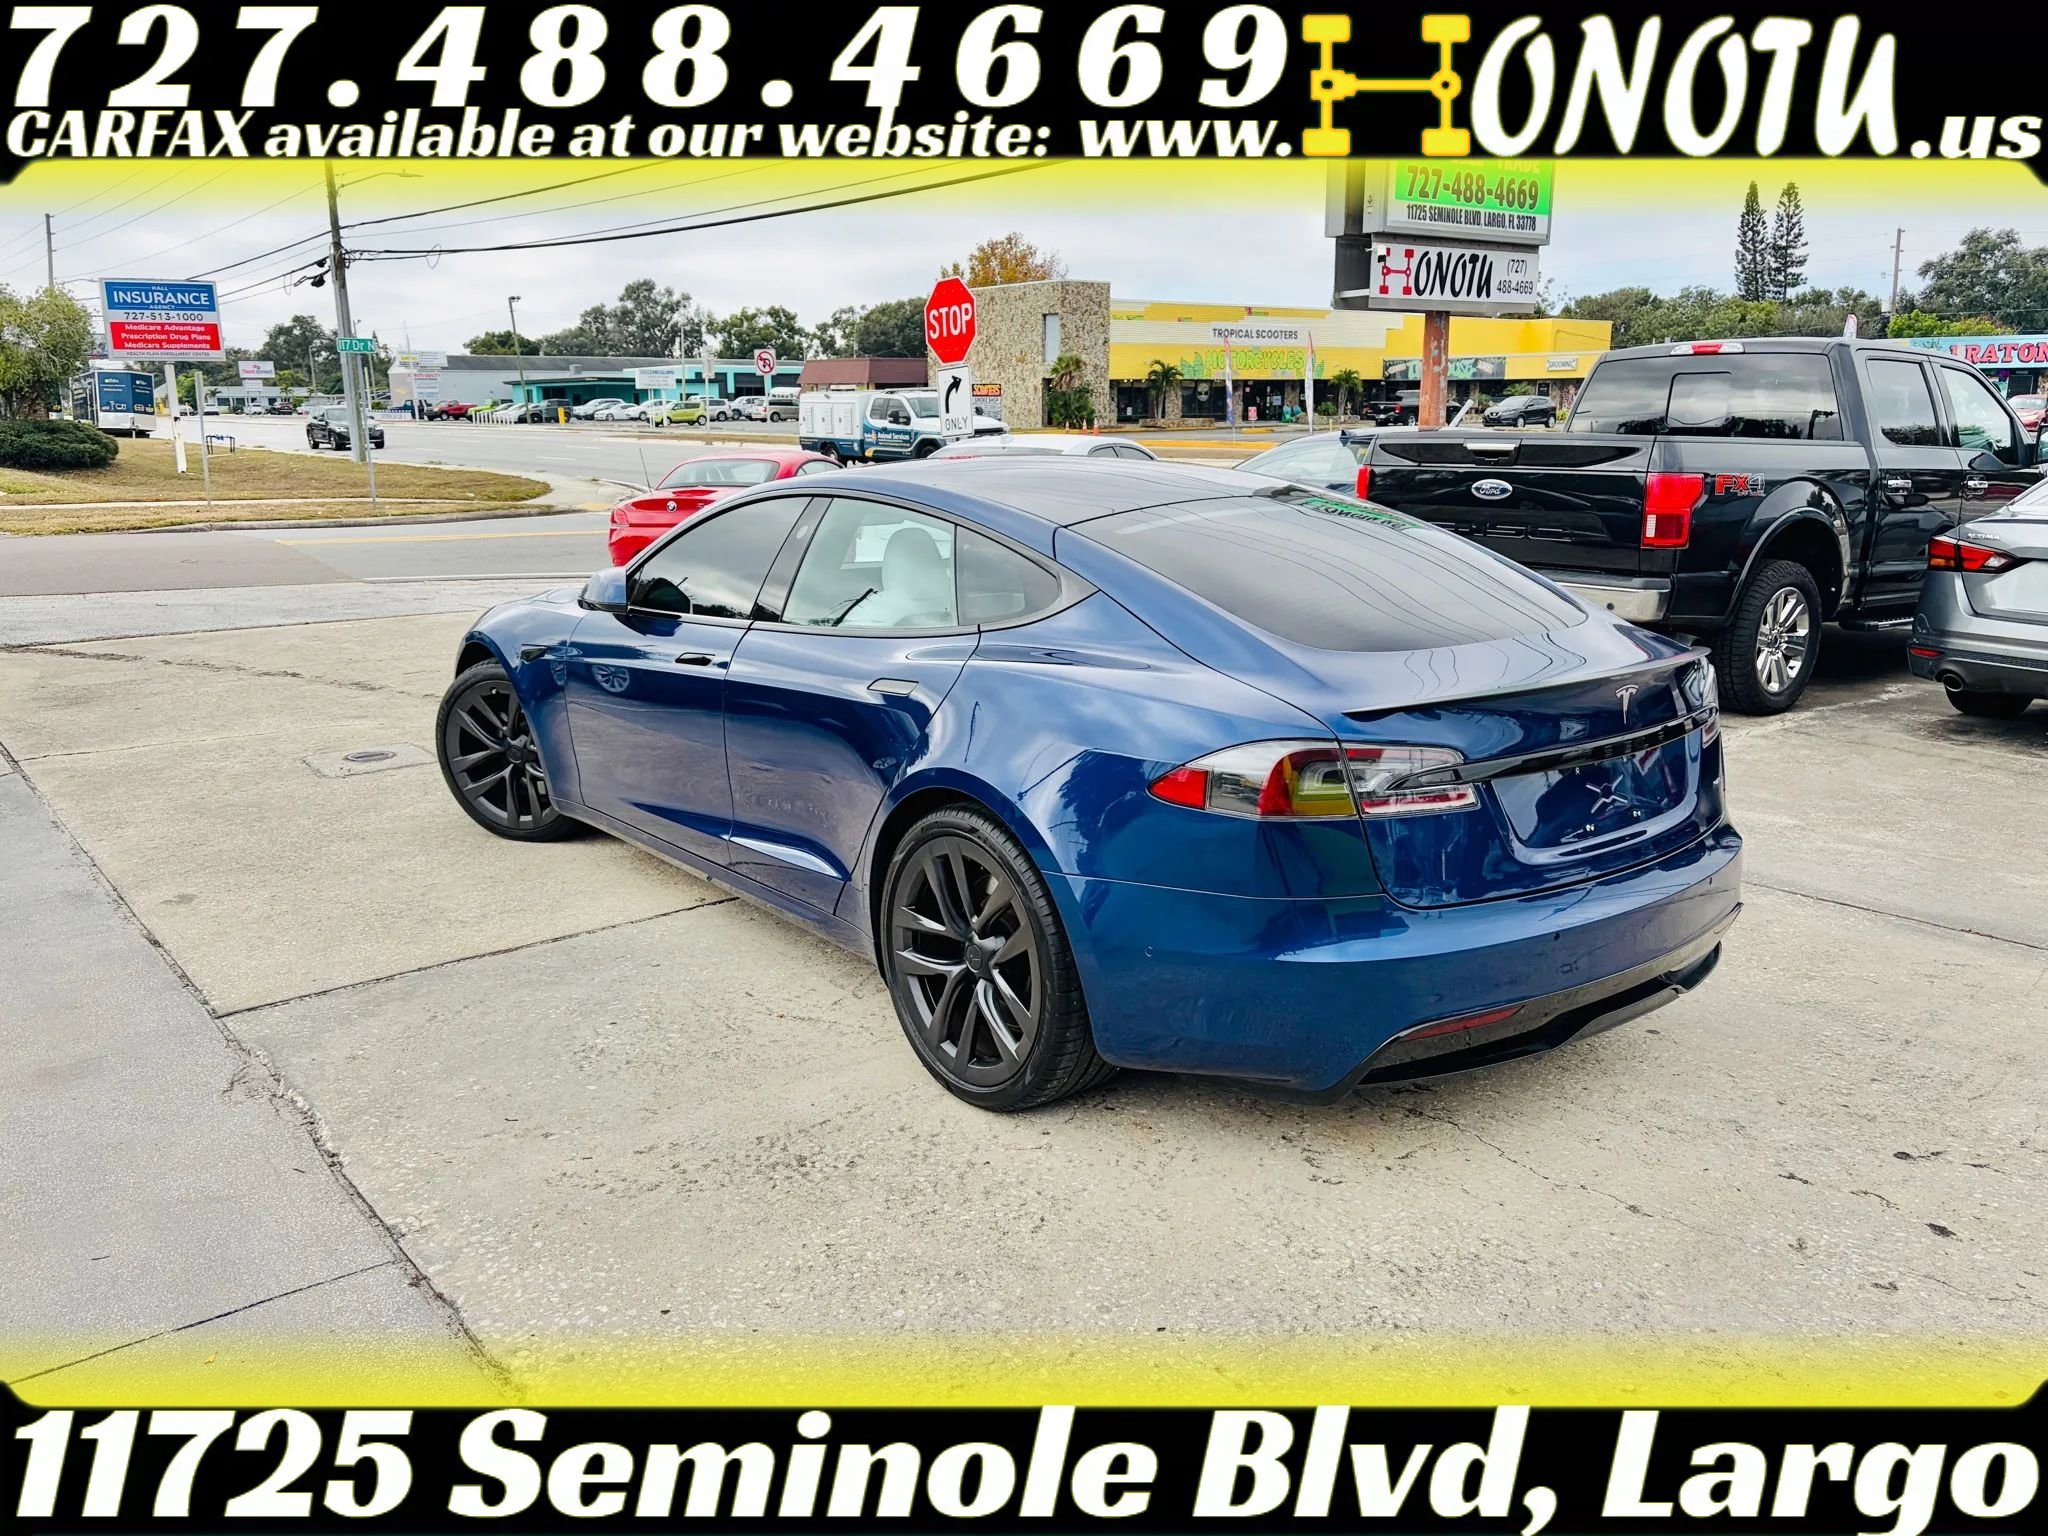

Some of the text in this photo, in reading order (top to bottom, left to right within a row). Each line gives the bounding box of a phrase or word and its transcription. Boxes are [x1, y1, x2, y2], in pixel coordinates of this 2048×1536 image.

[1407, 165, 1538, 210] 727-488-4669
[1407, 204, 1427, 221] 11725
[1428, 205, 1463, 225] SEMINOLE
[1508, 214, 1515, 229] FL
[1516, 215, 1537, 231] 33778
[1507, 259, 1527, 277] (727)
[1497, 279, 1533, 295] 488-4669
[113, 291, 210, 305] INSURANCE
[124, 312, 204, 321] 727-513-1000
[929, 302, 972, 340] STOP
[121, 333, 168, 341] Prescription
[1212, 328, 1298, 340] TROPICAL SCOOTERS
[162, 342, 211, 350] Supplements
[352, 340, 365, 350] Dr
[367, 340, 376, 351] N
[1205, 349, 1304, 371] MOTORCYCLES
[945, 416, 968, 431] ONLY
[893, 432, 911, 440] Services
[1715, 473, 1765, 495] FX4
[1967, 532, 2000, 540] ALTIMA
